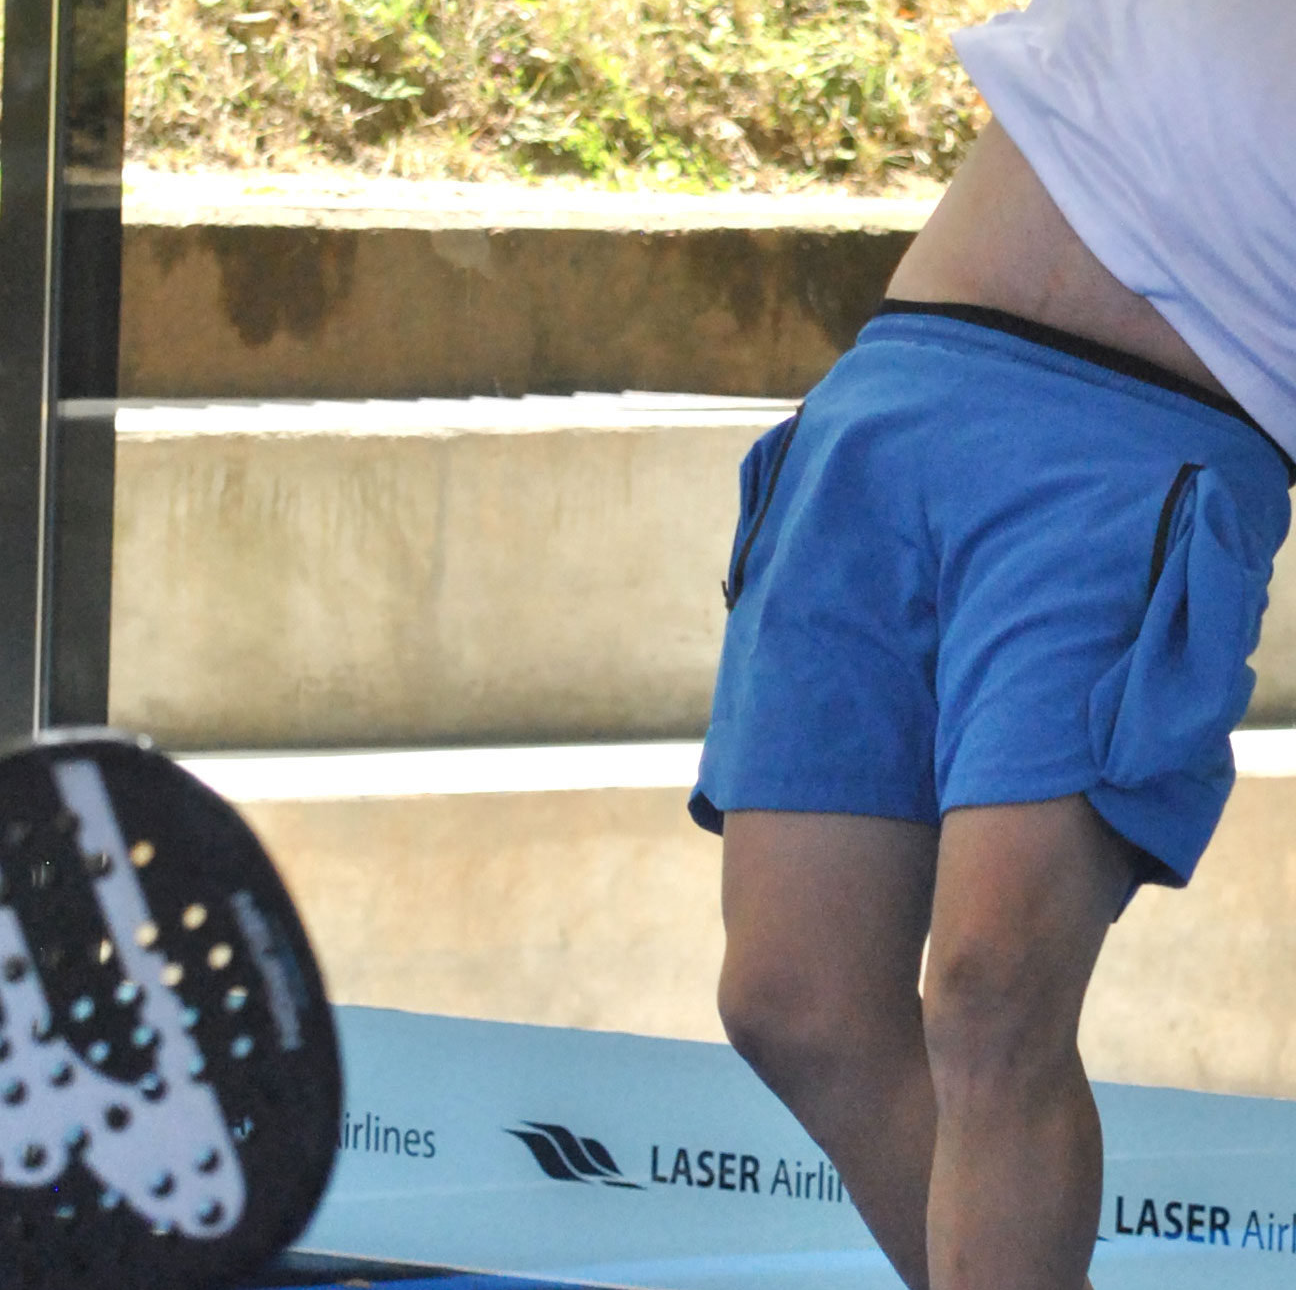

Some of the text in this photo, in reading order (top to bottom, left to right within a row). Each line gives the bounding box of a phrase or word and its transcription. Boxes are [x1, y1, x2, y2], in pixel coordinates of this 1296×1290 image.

[338, 1111, 436, 1159] irlines
[651, 1145, 760, 1194] LASER
[1116, 1196, 1231, 1247] LASER
